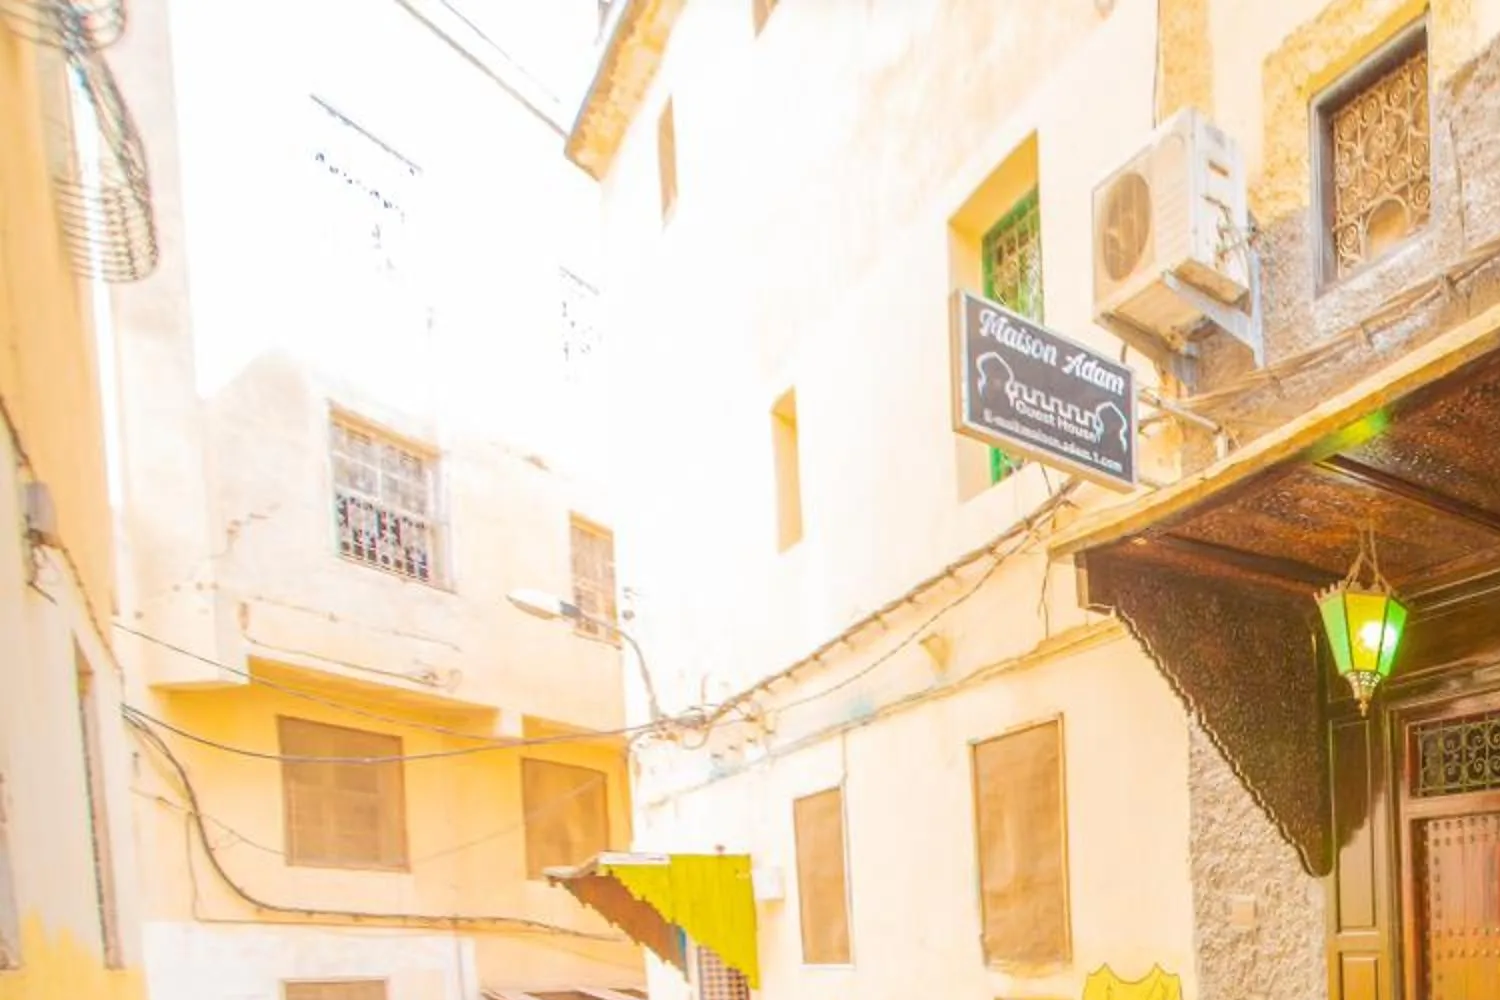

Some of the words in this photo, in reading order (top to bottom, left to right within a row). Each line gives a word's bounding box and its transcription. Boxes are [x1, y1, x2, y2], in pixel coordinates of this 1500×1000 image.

[979, 308, 1057, 366] Maison
[1062, 352, 1125, 396] Adam
[1016, 400, 1055, 424] Guest
[1057, 414, 1097, 443] House
